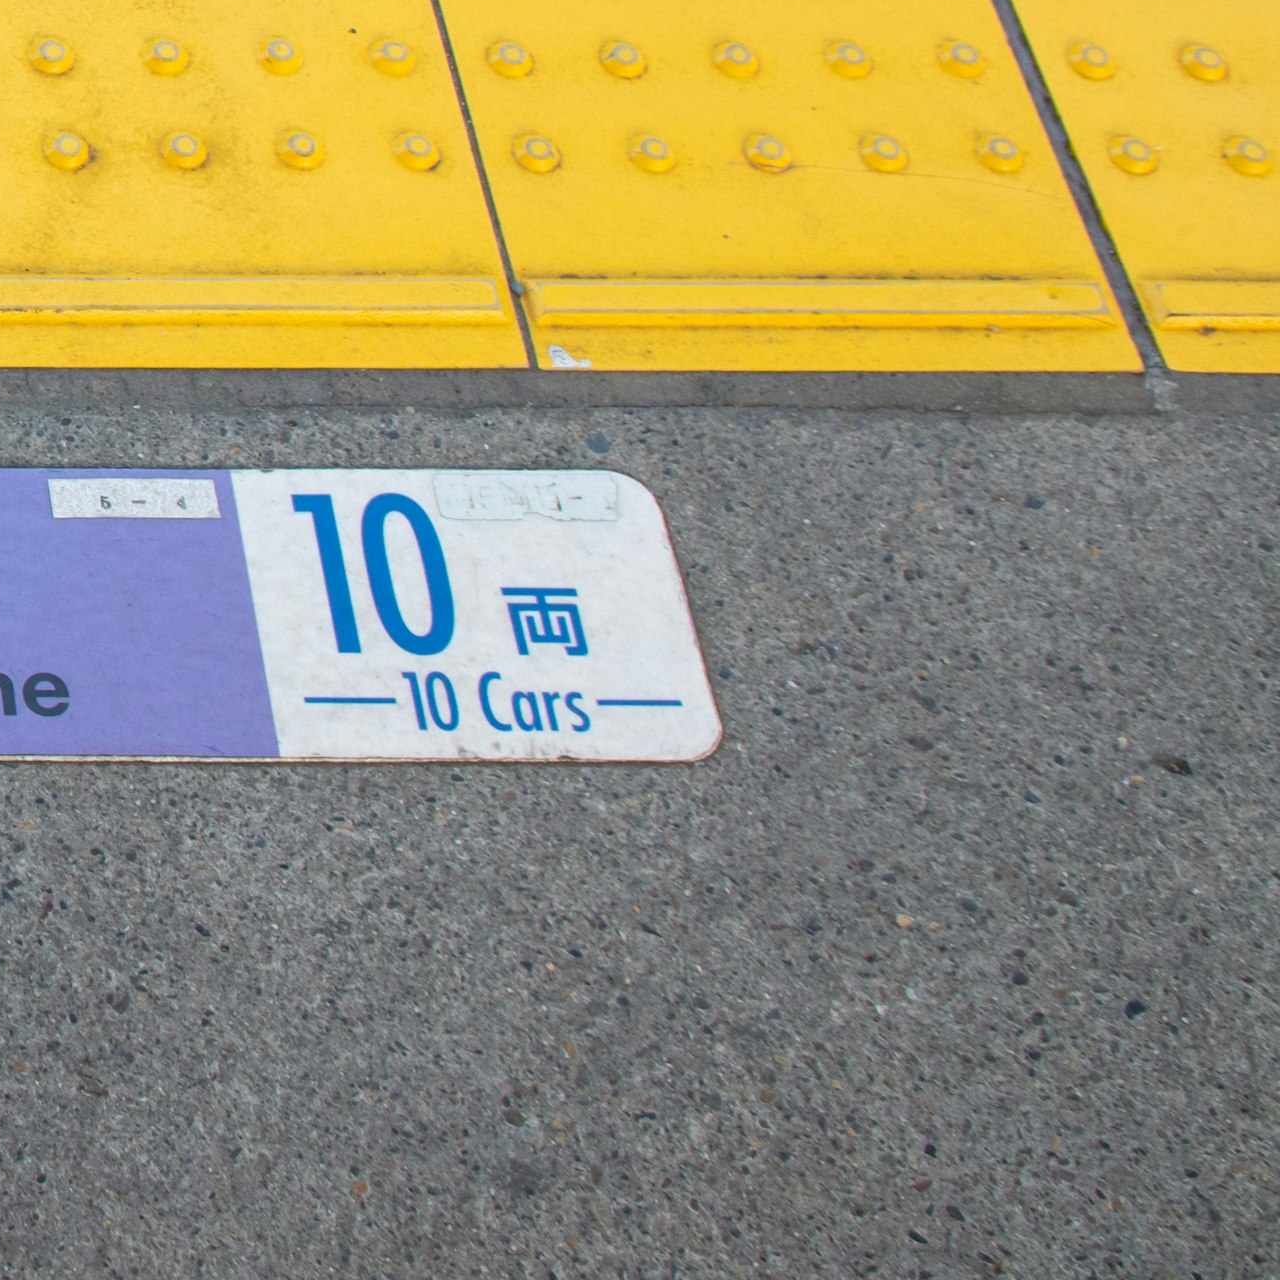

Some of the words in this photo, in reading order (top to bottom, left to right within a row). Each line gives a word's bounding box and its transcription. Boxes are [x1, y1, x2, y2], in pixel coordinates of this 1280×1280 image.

[292, 493, 455, 655] 10
[502, 588, 588, 656] 両
[403, 672, 459, 731] 10
[480, 672, 590, 732] Cars
